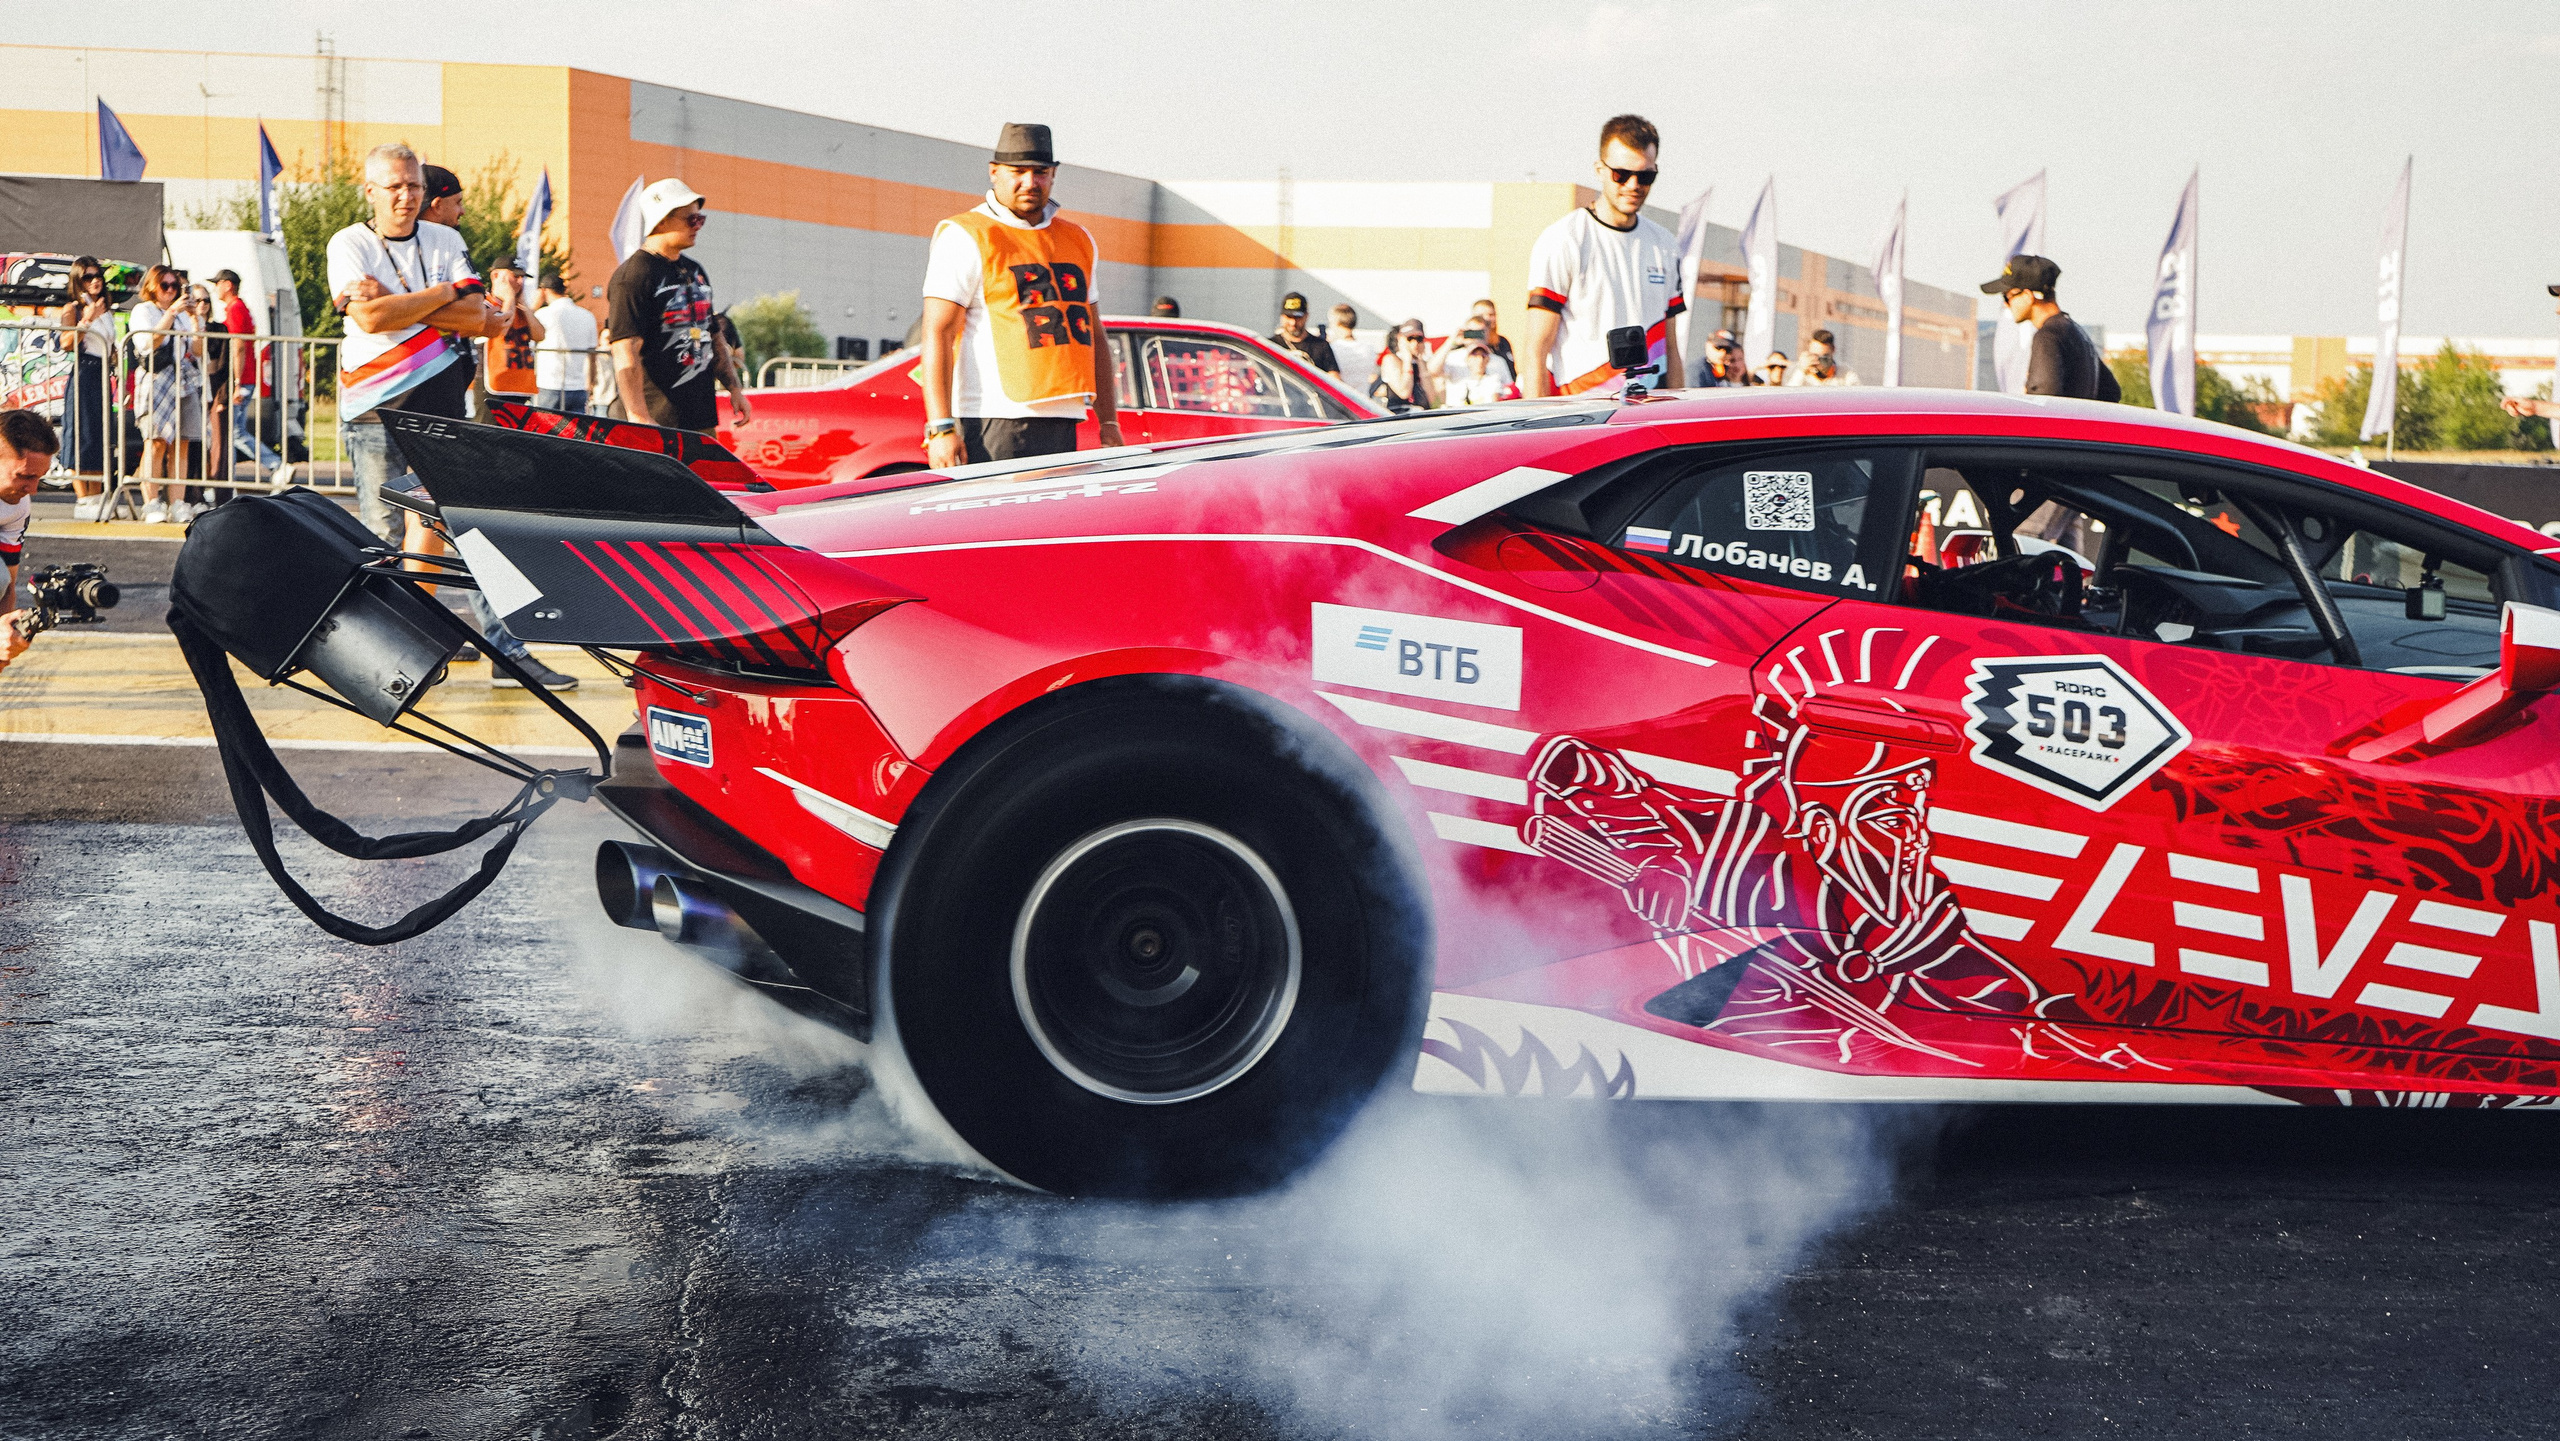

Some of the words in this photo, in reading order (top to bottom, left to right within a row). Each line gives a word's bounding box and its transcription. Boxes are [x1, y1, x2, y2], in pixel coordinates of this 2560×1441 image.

[1009, 263, 1088, 305] RD
[1020, 305, 1091, 349] RC
[1673, 533, 1833, 582] Лобачев
[1840, 563, 1878, 592] А.
[1399, 638, 1480, 685] ВТБ
[2055, 680, 2107, 698] RDRC
[2027, 693, 2127, 750] 503
[2047, 745, 2112, 763] RACEPARK
